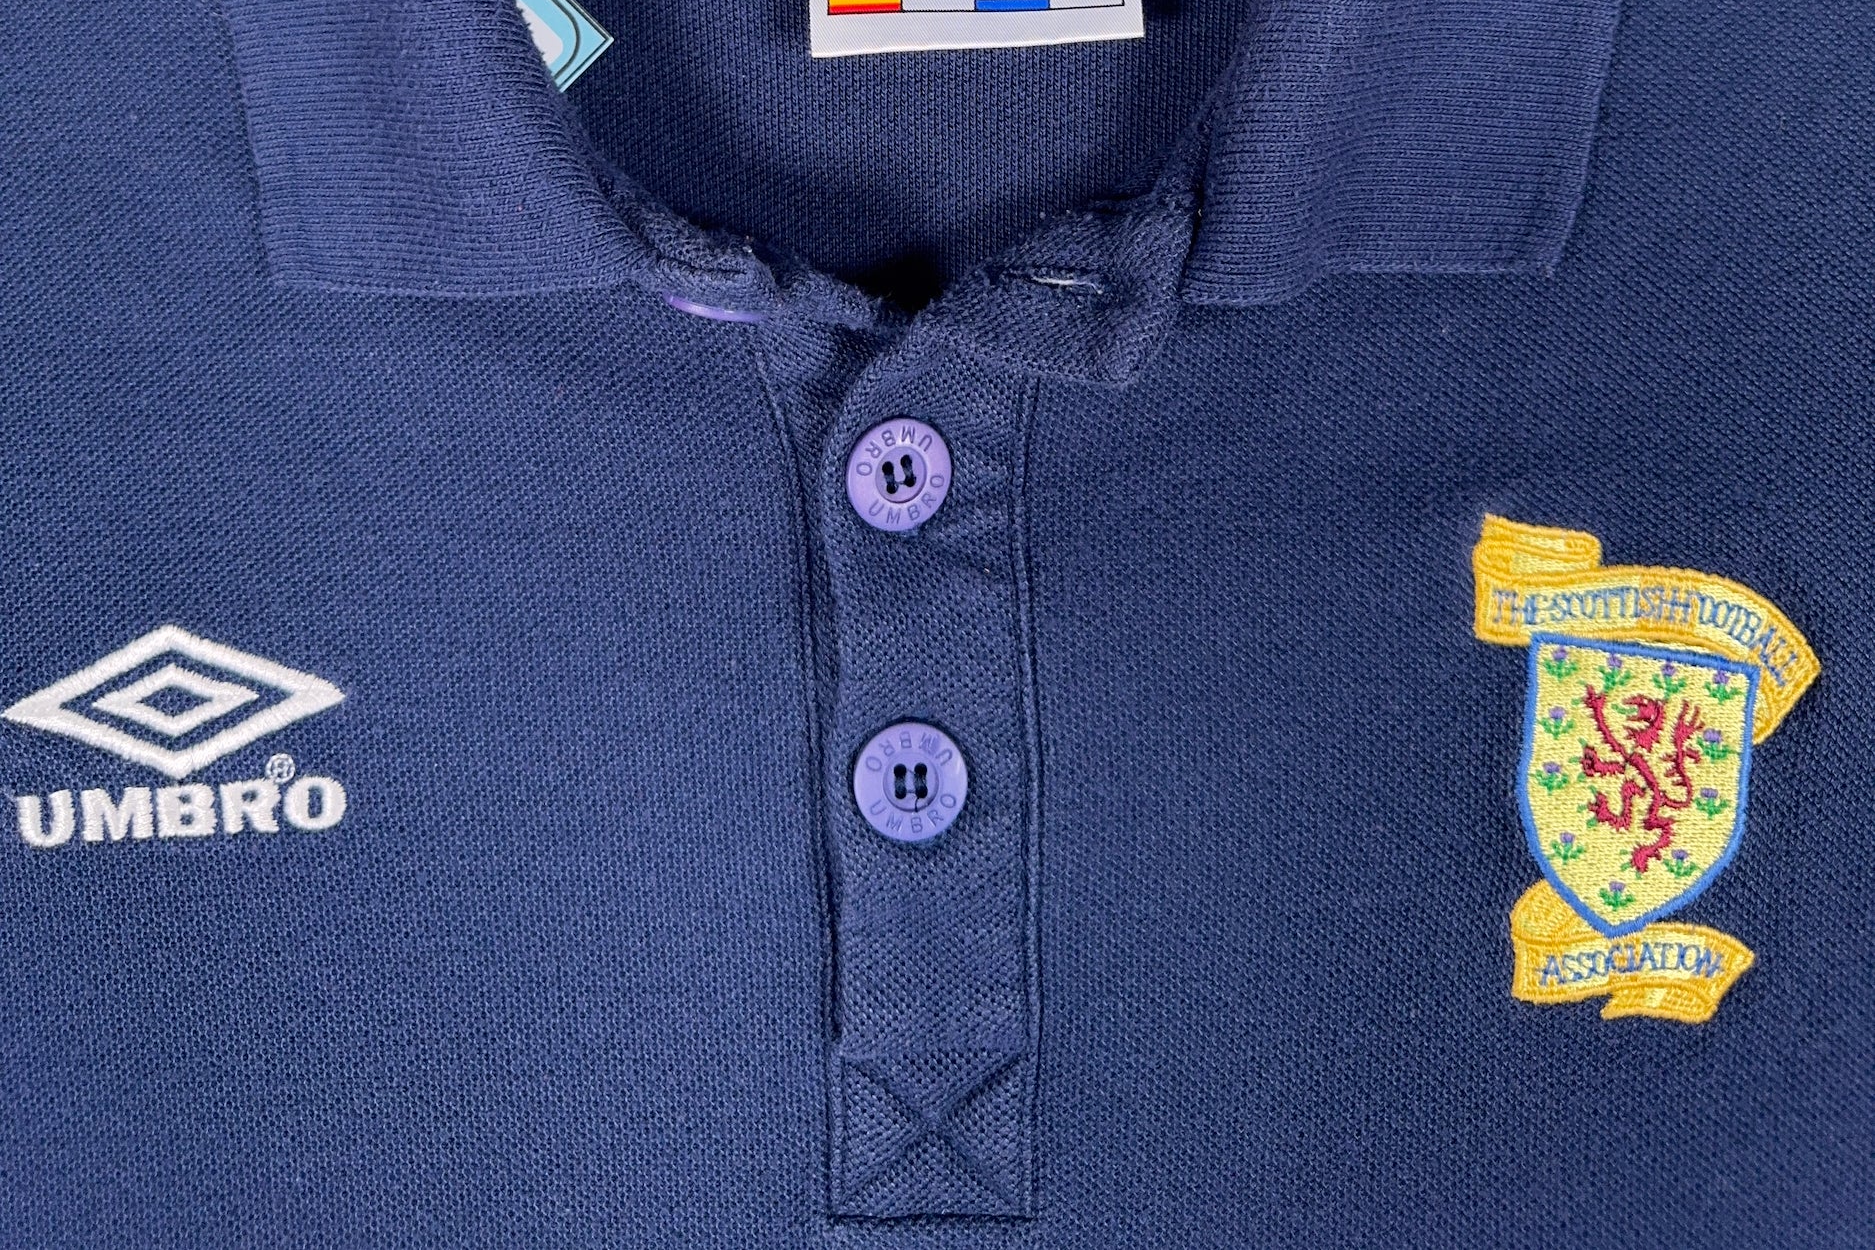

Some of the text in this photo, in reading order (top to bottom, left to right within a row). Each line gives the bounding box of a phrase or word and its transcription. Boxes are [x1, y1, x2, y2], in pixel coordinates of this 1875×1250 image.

[856, 425, 933, 476] UMBRO
[868, 475, 945, 525] UMBRO
[17, 775, 348, 847] UMBRO
[870, 793, 957, 834] UMBRO
[1537, 941, 1725, 986] ASSOCIATION
